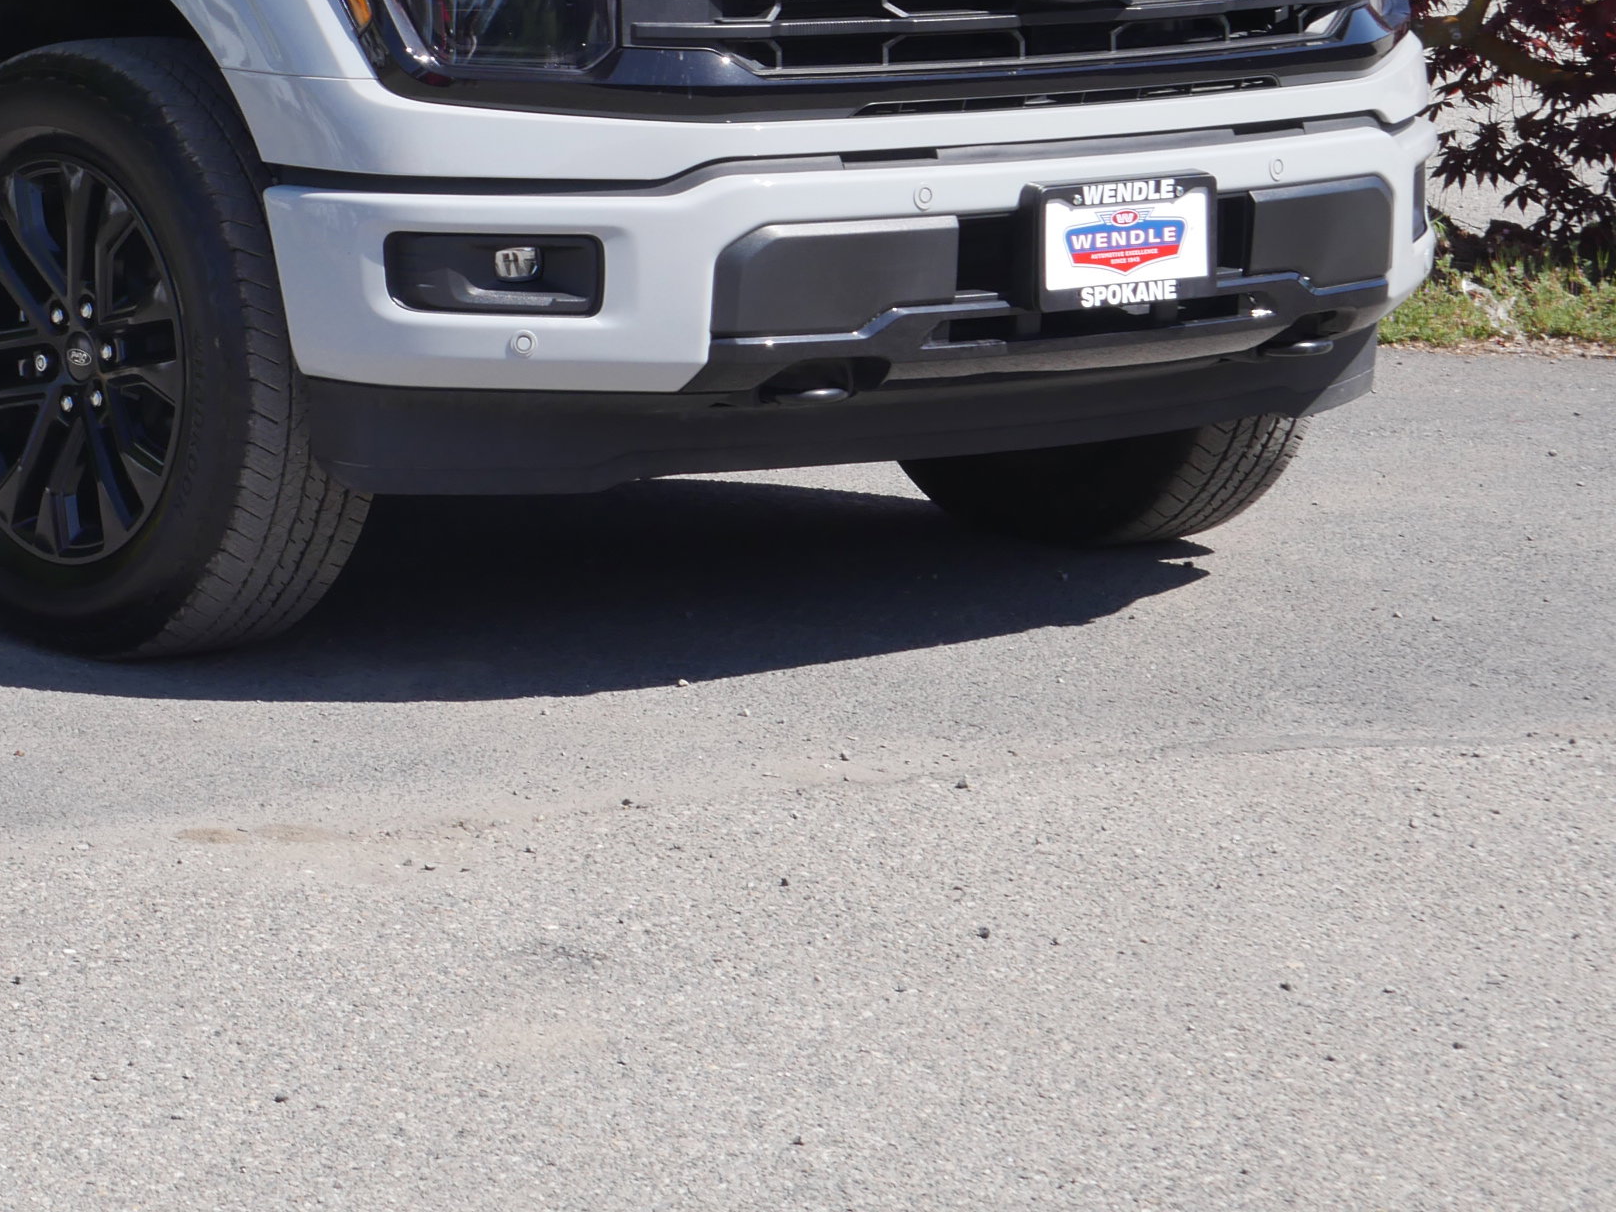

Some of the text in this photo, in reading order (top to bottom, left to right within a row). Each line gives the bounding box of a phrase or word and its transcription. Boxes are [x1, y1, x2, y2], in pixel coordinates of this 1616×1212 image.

[1082, 179, 1175, 205] WENDLE
[1071, 226, 1177, 250] WENDLE
[1080, 279, 1177, 308] SPOKANE
